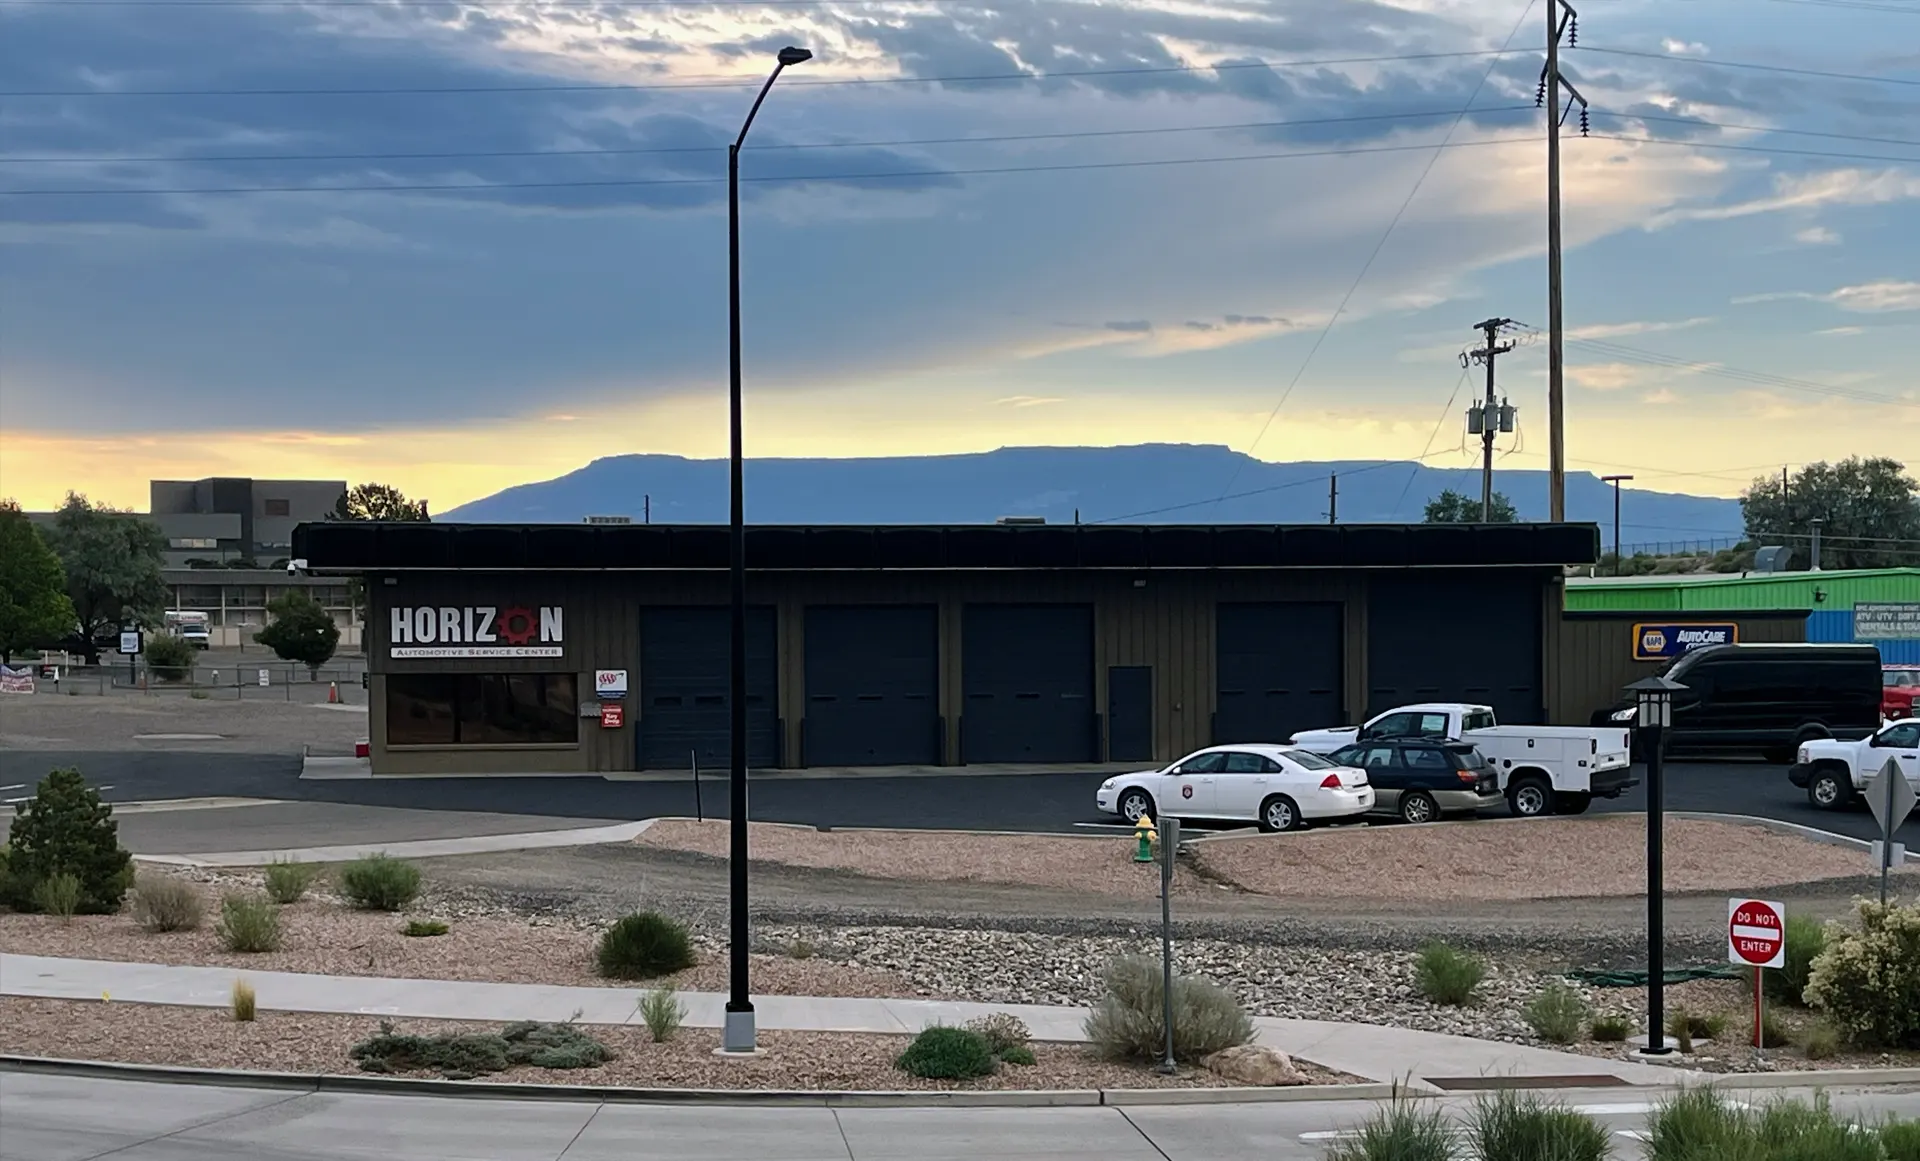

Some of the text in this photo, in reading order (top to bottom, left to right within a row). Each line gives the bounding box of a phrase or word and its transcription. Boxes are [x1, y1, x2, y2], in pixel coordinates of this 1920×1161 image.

[1856, 612, 1871, 620] ATV
[1877, 612, 1893, 621] UTV
[391, 606, 563, 644] HORIZON
[1860, 622, 1895, 630] RENTALS
[1646, 636, 1662, 647] NAPA
[1737, 911, 1775, 926] DO NOT
[1741, 940, 1771, 953] ENTER
